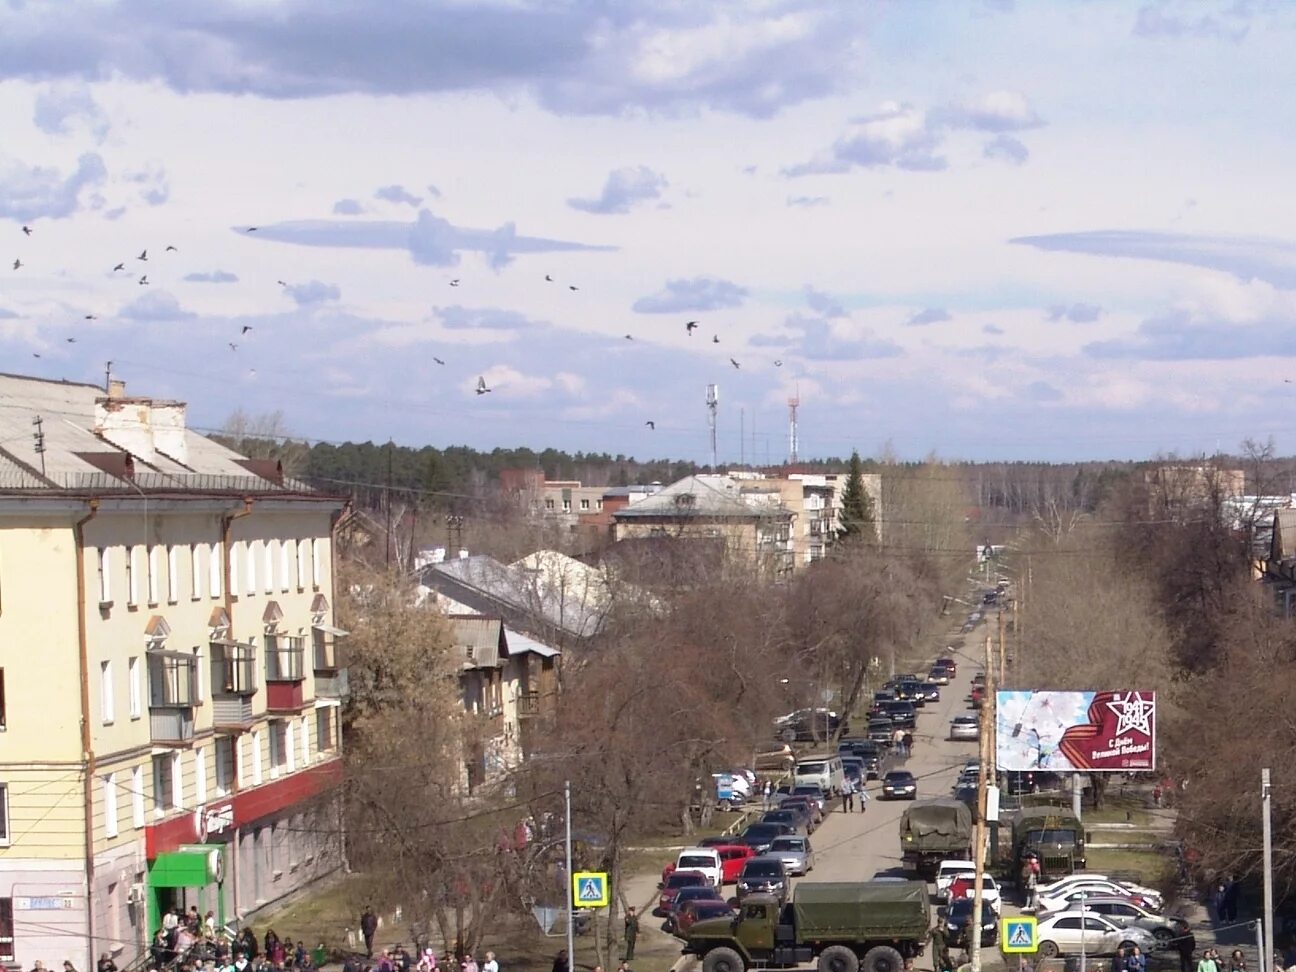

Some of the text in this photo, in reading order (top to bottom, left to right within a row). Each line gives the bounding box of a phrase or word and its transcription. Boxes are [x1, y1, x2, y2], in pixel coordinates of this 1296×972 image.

[1122, 713, 1146, 729] 1945
[1108, 739, 1114, 748] С
[1092, 749, 1120, 760] Великой
